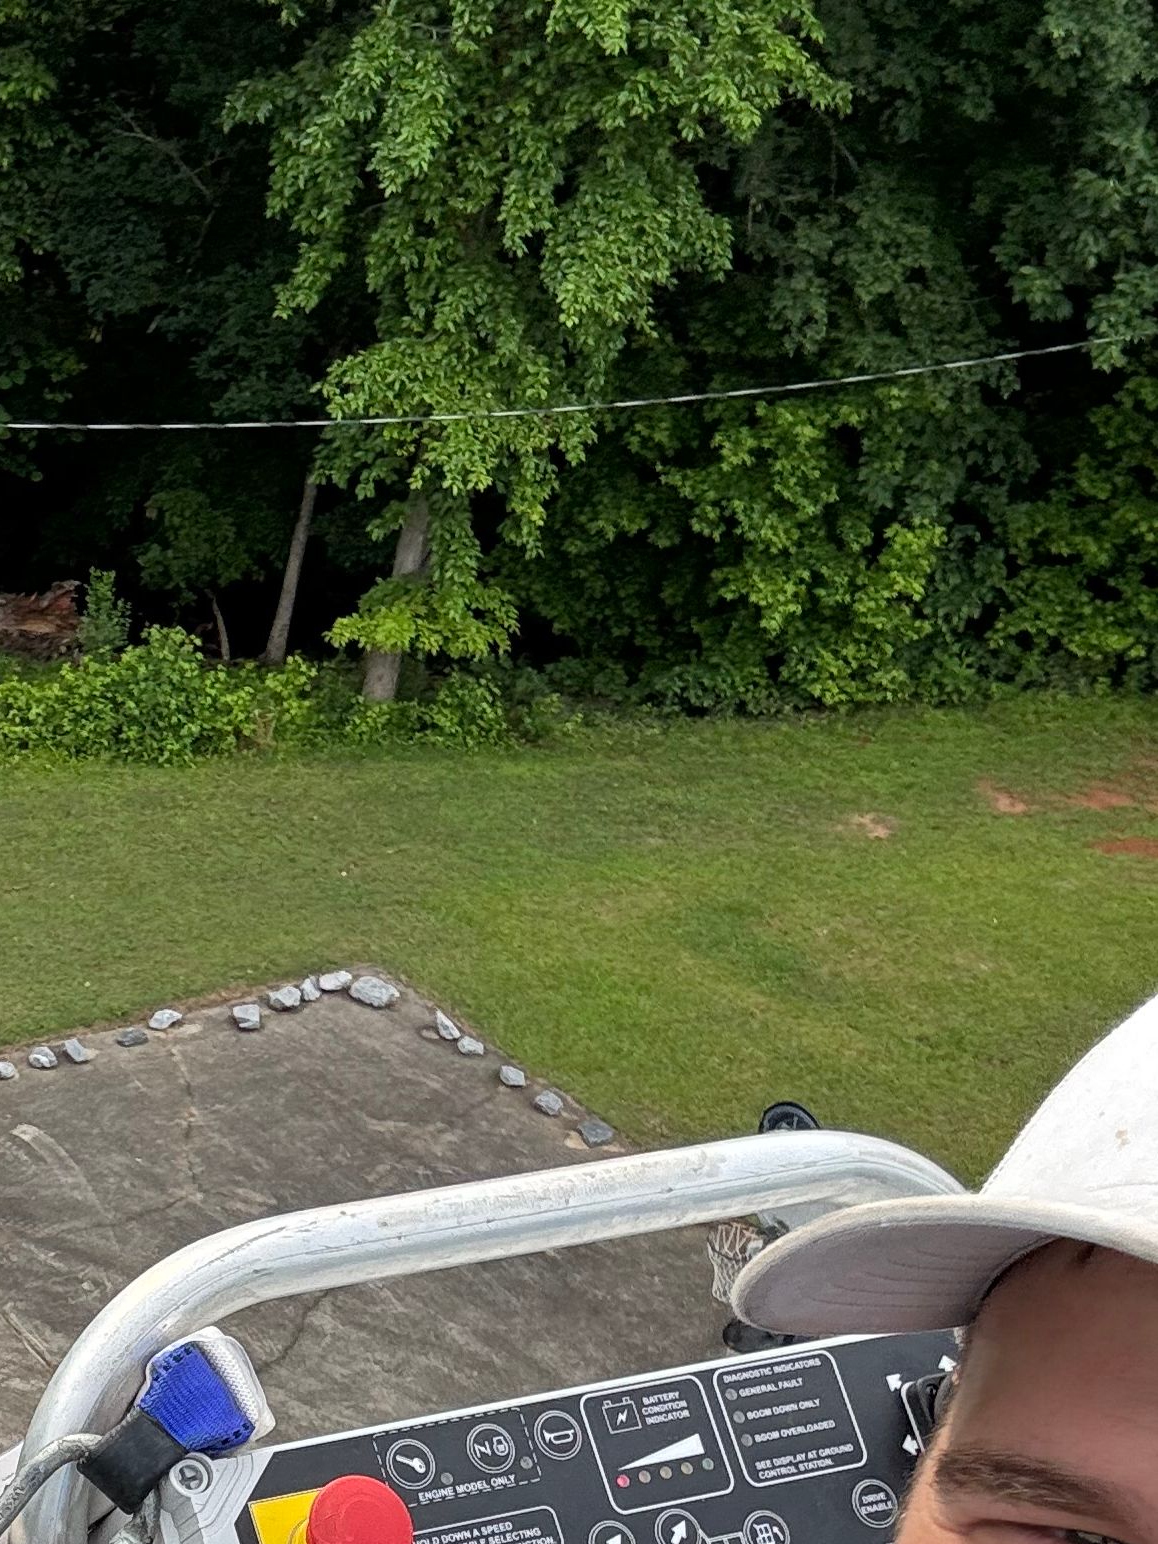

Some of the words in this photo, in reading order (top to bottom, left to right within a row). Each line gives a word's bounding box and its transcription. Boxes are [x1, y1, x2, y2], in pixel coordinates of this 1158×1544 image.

[723, 1367, 773, 1383] DIAGNOSTIC
[774, 1358, 821, 1374] INDICATORS
[739, 1383, 778, 1397] GENERAL
[778, 1378, 803, 1390] FAULT
[643, 1391, 680, 1405] BATTERY
[642, 1400, 687, 1415] CONDITION
[747, 1407, 772, 1420] BOOM
[773, 1403, 798, 1415] DOWN
[799, 1399, 820, 1410] ONLY
[646, 1410, 690, 1425] INDICATOR
[754, 1429, 779, 1443] BOOM
[780, 1420, 835, 1438] OVERLOADED
[755, 1458, 772, 1470] SEE
[773, 1452, 806, 1467] DISPLAY
[806, 1450, 817, 1460] AT
[818, 1444, 854, 1458] GROUND
[759, 1466, 798, 1480] CONTROL
[418, 1487, 454, 1501] ENGINE
[456, 1481, 490, 1493] MODEL
[491, 1474, 516, 1487] ONLY
[861, 1491, 887, 1504] DRIVE
[860, 1500, 893, 1515] ENABLE
[443, 1531, 471, 1543] DOWN
[473, 1528, 481, 1538] A
[482, 1522, 513, 1536] SPEED
[488, 1528, 541, 1544] SELECTING
